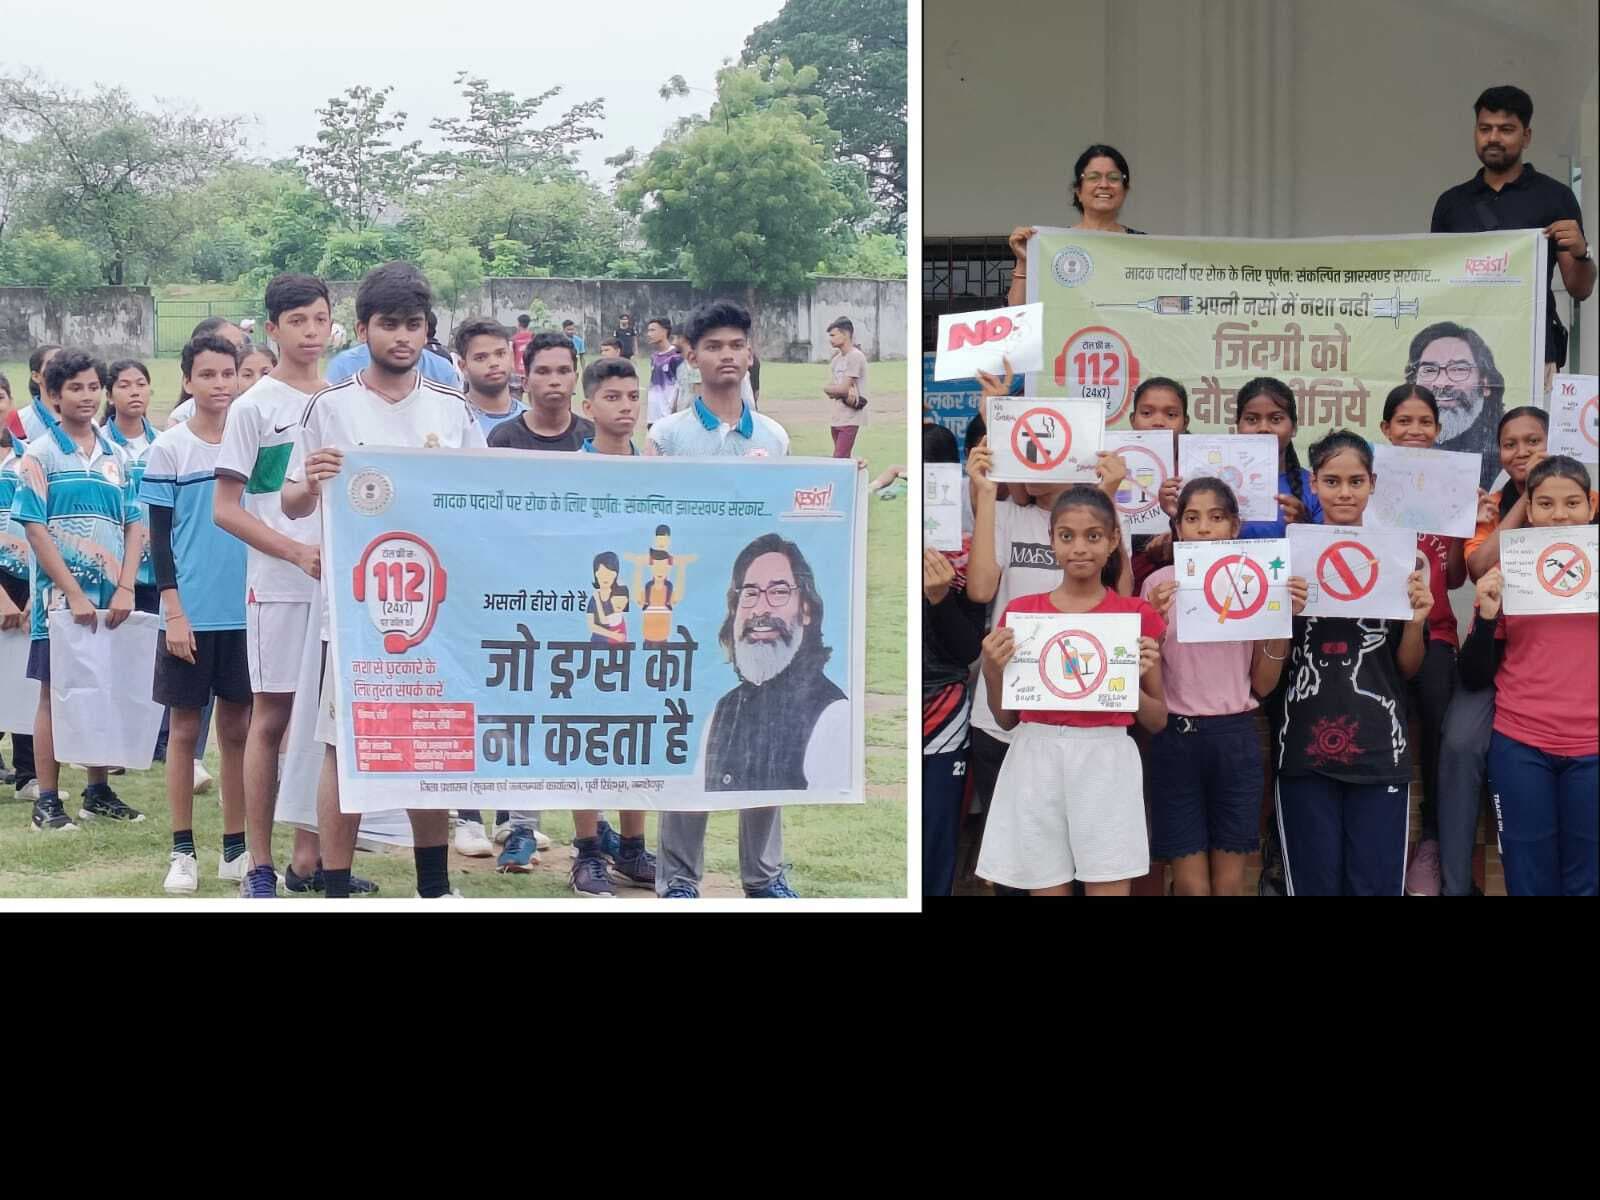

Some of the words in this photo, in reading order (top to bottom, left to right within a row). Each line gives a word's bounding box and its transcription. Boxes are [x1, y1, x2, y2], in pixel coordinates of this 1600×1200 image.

[1124, 267, 1155, 281] मादक
[1157, 263, 1187, 281] पदार्थों
[1189, 267, 1202, 281] पर
[1205, 265, 1227, 281] रोक
[1228, 265, 1239, 281] के
[1240, 265, 1262, 281] लिए
[1296, 266, 1341, 284] संकल्पित
[1344, 269, 1391, 284] झारखण्ड
[1196, 290, 1241, 316] अपनी
[1242, 290, 1279, 317] नसों
[1281, 291, 1297, 317] में
[1300, 298, 1336, 317] नशा
[1338, 291, 1373, 318] नहीं
[1212, 320, 1304, 371] जिंदगी
[1309, 322, 1352, 371] को
[1073, 352, 1120, 386] 112
[1082, 386, 1111, 399] (24x7)
[432, 492, 468, 511] मादक
[506, 494, 522, 512] पर
[523, 491, 549, 513] रोक
[550, 491, 561, 513] के
[563, 491, 588, 513] लिए
[623, 493, 673, 515] संकल्पित
[675, 500, 726, 517] झारखण्ड
[373, 561, 426, 602] 112
[483, 590, 528, 612] असली
[530, 590, 558, 612] हीरो
[560, 591, 575, 612] वो
[577, 591, 588, 613] है
[352, 660, 372, 675] नशा
[373, 658, 384, 675] से
[424, 658, 437, 675] के
[480, 623, 541, 692] जो
[547, 641, 636, 699] ड्रग्स
[642, 624, 699, 692] को
[396, 681, 424, 698] संपर्क
[425, 680, 445, 698] करें
[477, 714, 535, 766] ना
[541, 714, 657, 766] कहता
[663, 697, 694, 766] है
